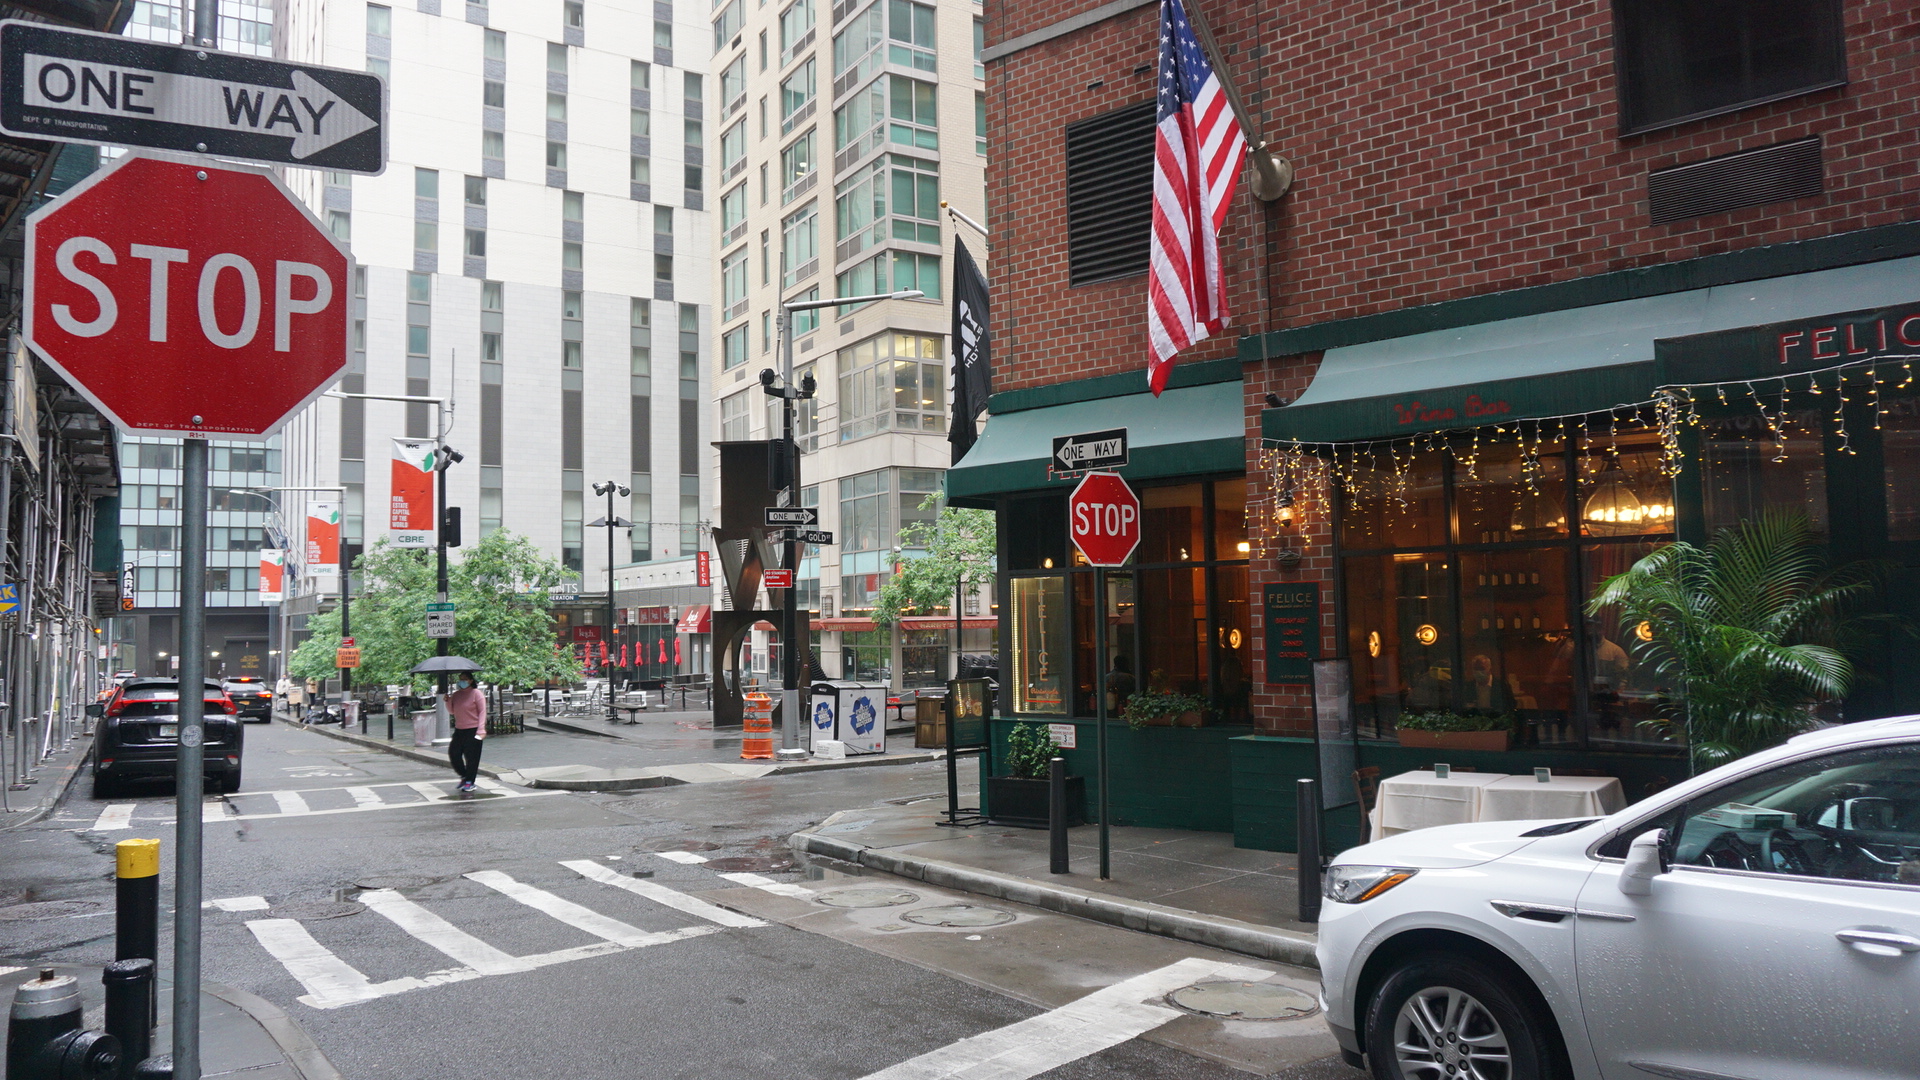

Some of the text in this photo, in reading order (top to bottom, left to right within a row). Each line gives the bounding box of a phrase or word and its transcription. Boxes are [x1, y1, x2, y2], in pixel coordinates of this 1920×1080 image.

[38, 62, 336, 135] ONE WAY
[54, 119, 108, 132] TRANSPORTATION
[50, 236, 333, 353] STOP
[1393, 394, 1511, 425] Wine Bar
[180, 424, 256, 433] TRANSPORTATION
[1063, 440, 1118, 460] ONE WAY
[1075, 501, 1136, 537] STOP
[808, 533, 827, 542] GOLD
[123, 563, 134, 596] PARK
[700, 554, 708, 585] ketch
[1268, 592, 1313, 604] FELICE
[1037, 589, 1049, 681] FELICE
